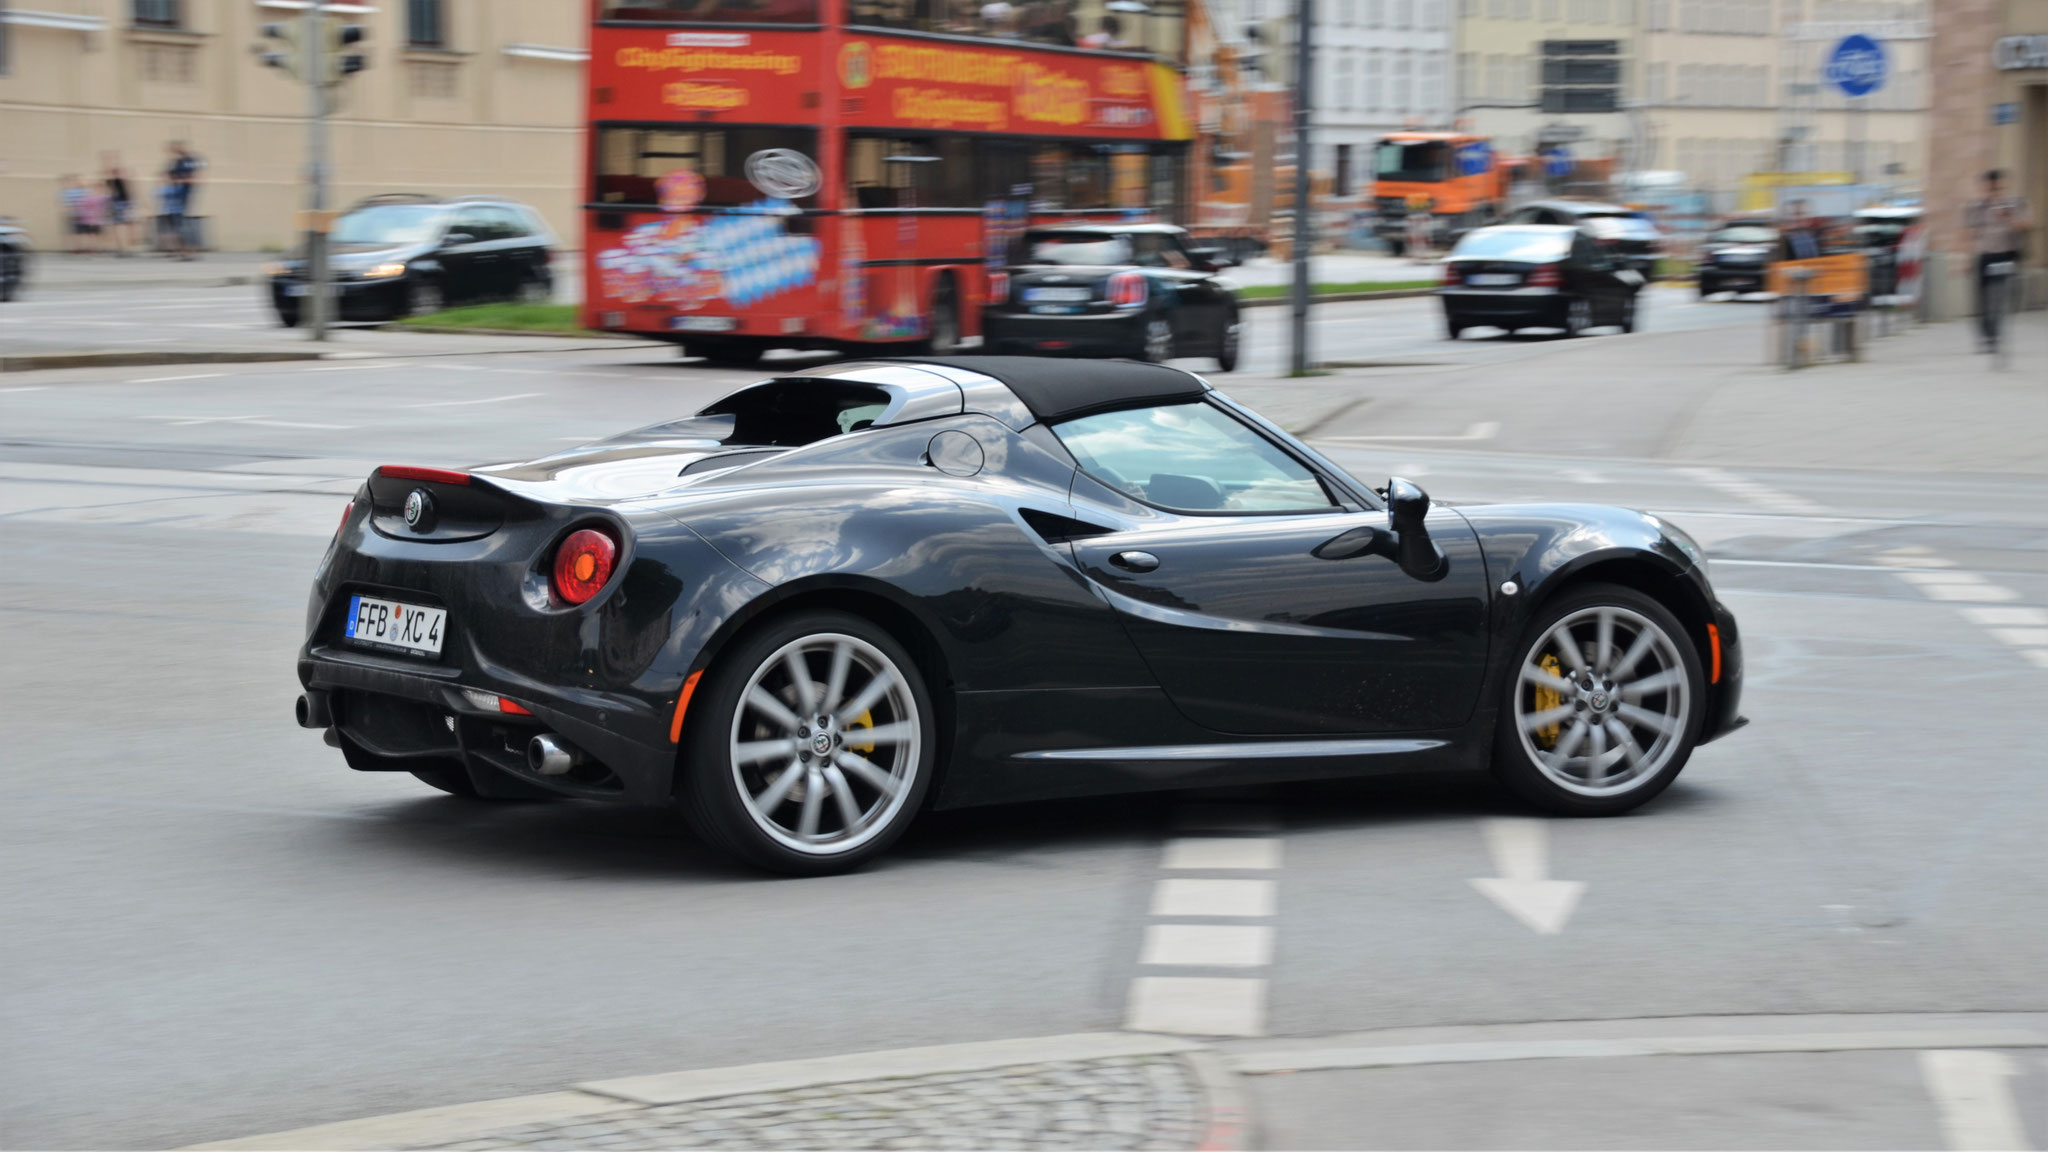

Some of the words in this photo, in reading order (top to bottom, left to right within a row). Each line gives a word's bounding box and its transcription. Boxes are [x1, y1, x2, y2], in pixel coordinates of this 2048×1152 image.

[355, 602, 388, 637] FFB
[401, 609, 425, 643] XC
[428, 614, 440, 646] 4
